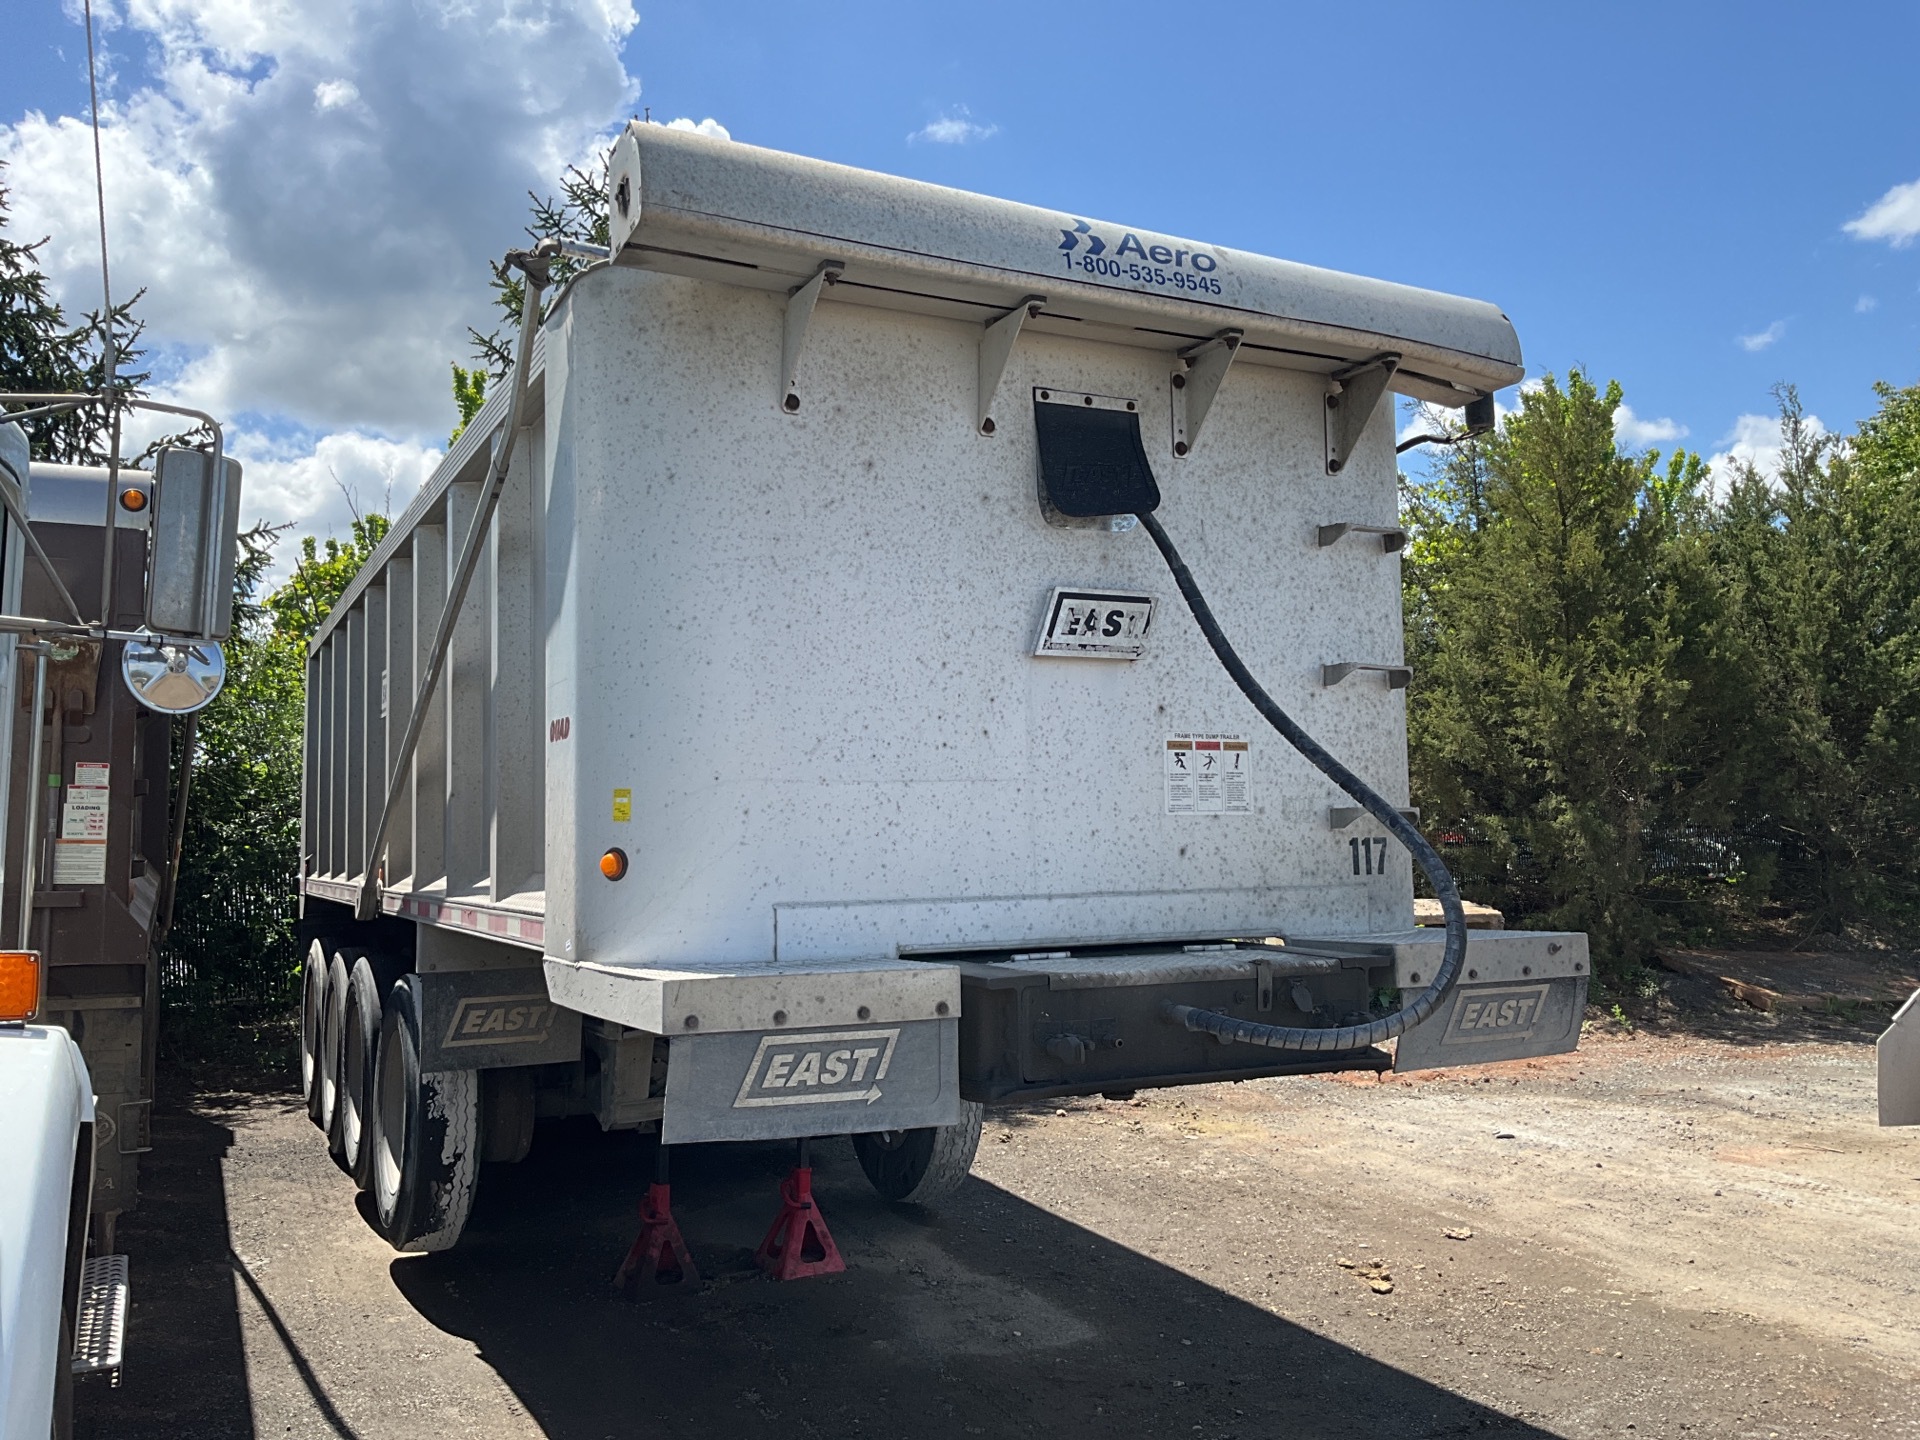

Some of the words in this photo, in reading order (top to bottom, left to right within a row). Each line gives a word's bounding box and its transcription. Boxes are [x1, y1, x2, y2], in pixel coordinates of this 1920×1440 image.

[1115, 233, 1217, 272] Aero
[1062, 252, 1222, 295] 1-800-535-9545
[1349, 837, 1387, 875] 117
[462, 1006, 548, 1034] EAST
[1460, 998, 1536, 1030] EAST
[762, 1047, 879, 1089] EAST
